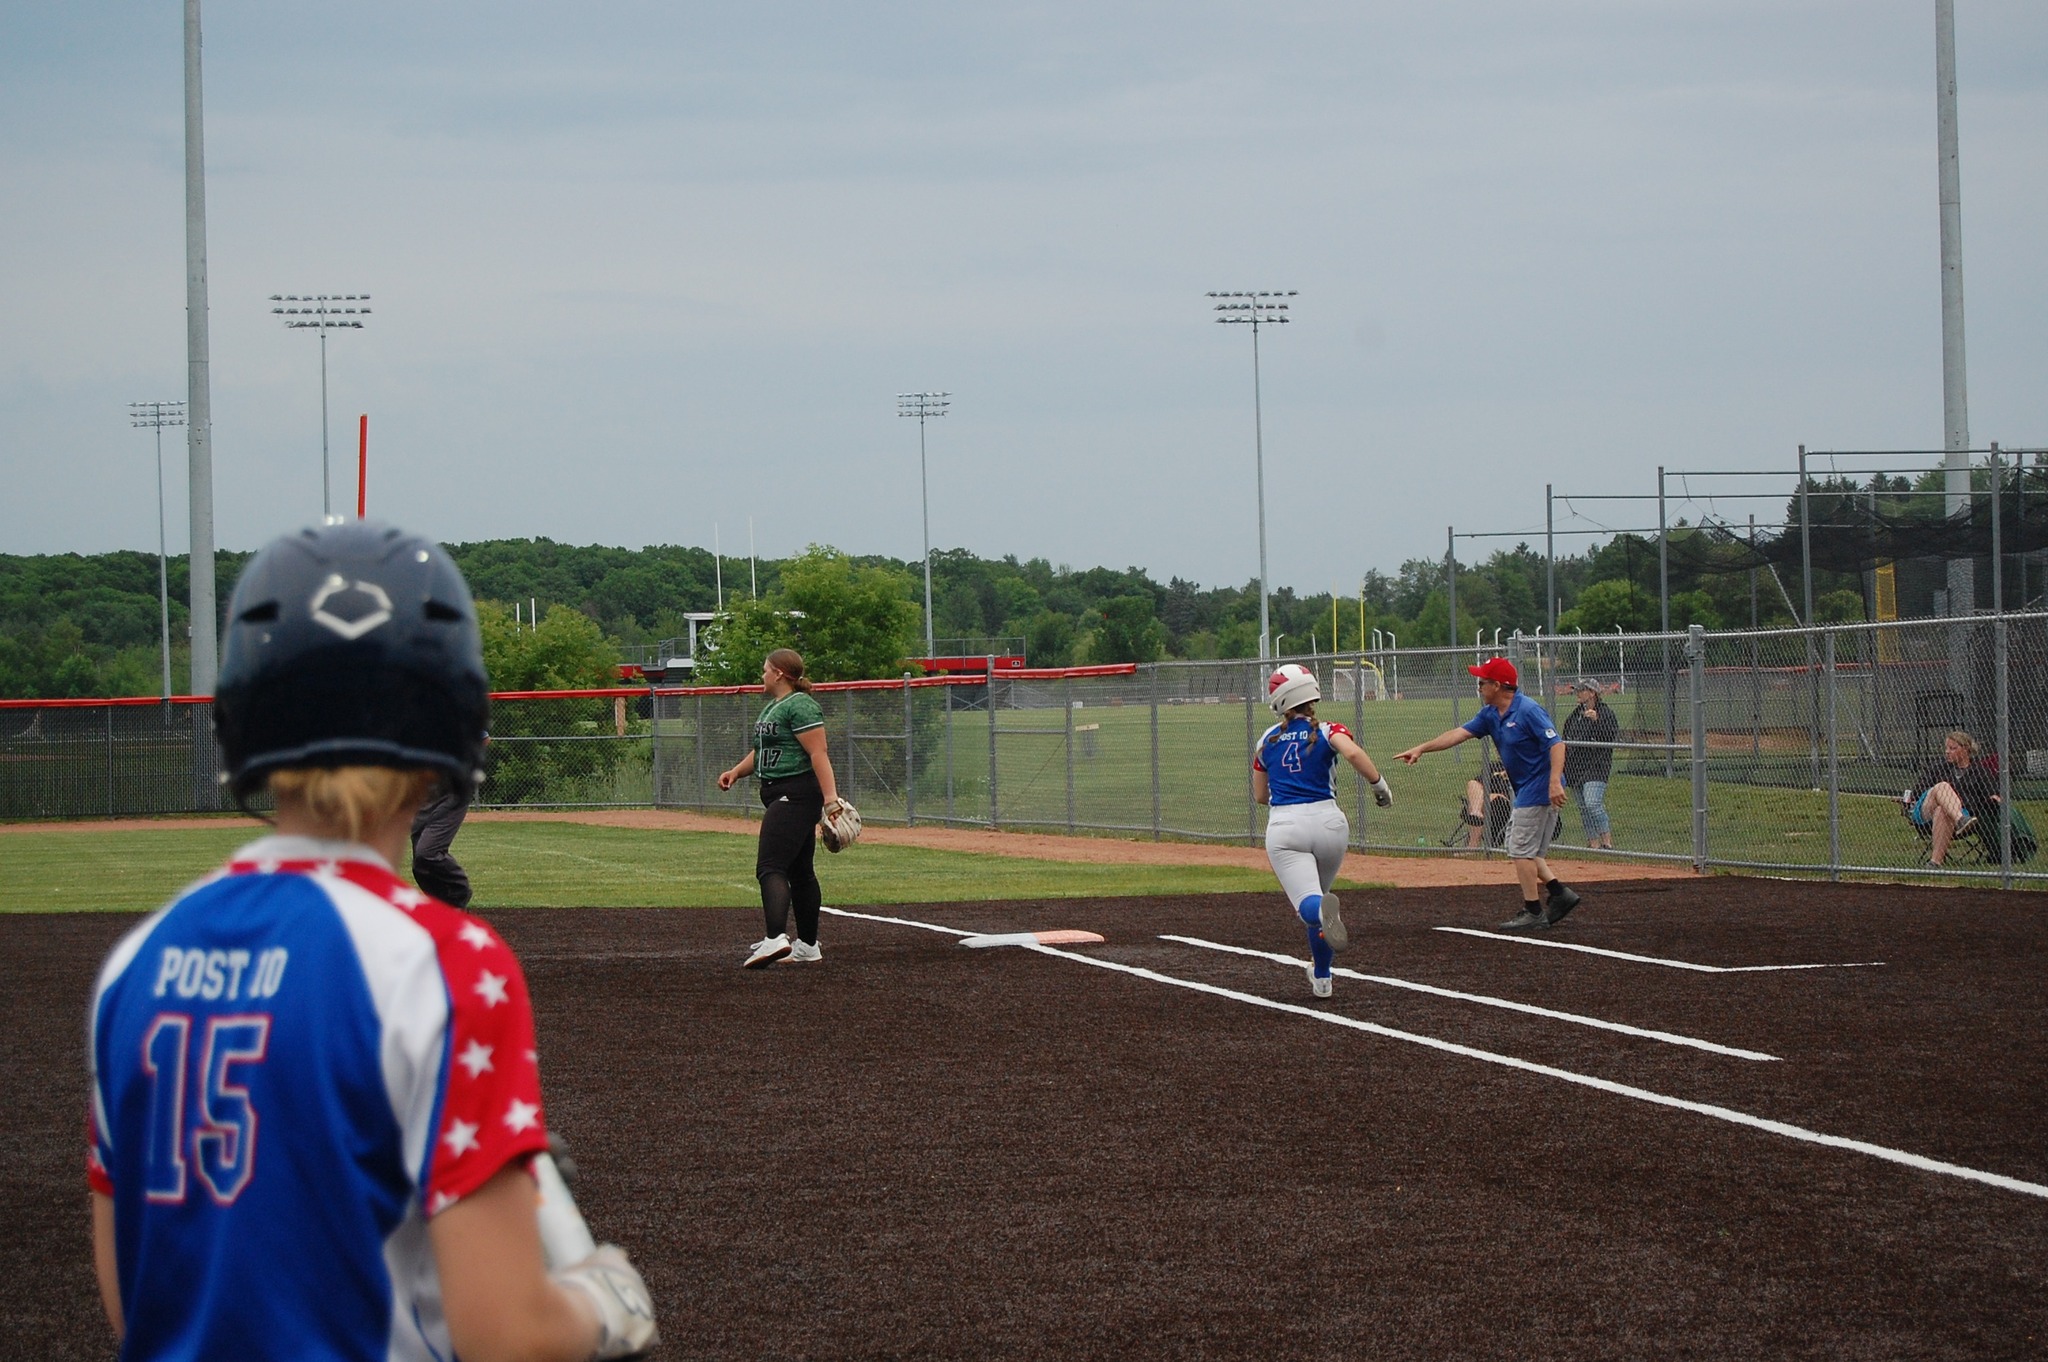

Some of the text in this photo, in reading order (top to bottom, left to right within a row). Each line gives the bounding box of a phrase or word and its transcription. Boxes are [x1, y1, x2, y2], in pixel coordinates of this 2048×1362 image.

[1299, 730, 1308, 740] 10
[762, 748, 783, 768] 17
[1281, 741, 1302, 773] 4
[154, 946, 289, 1000] POST 10
[143, 1012, 272, 1207] 15
